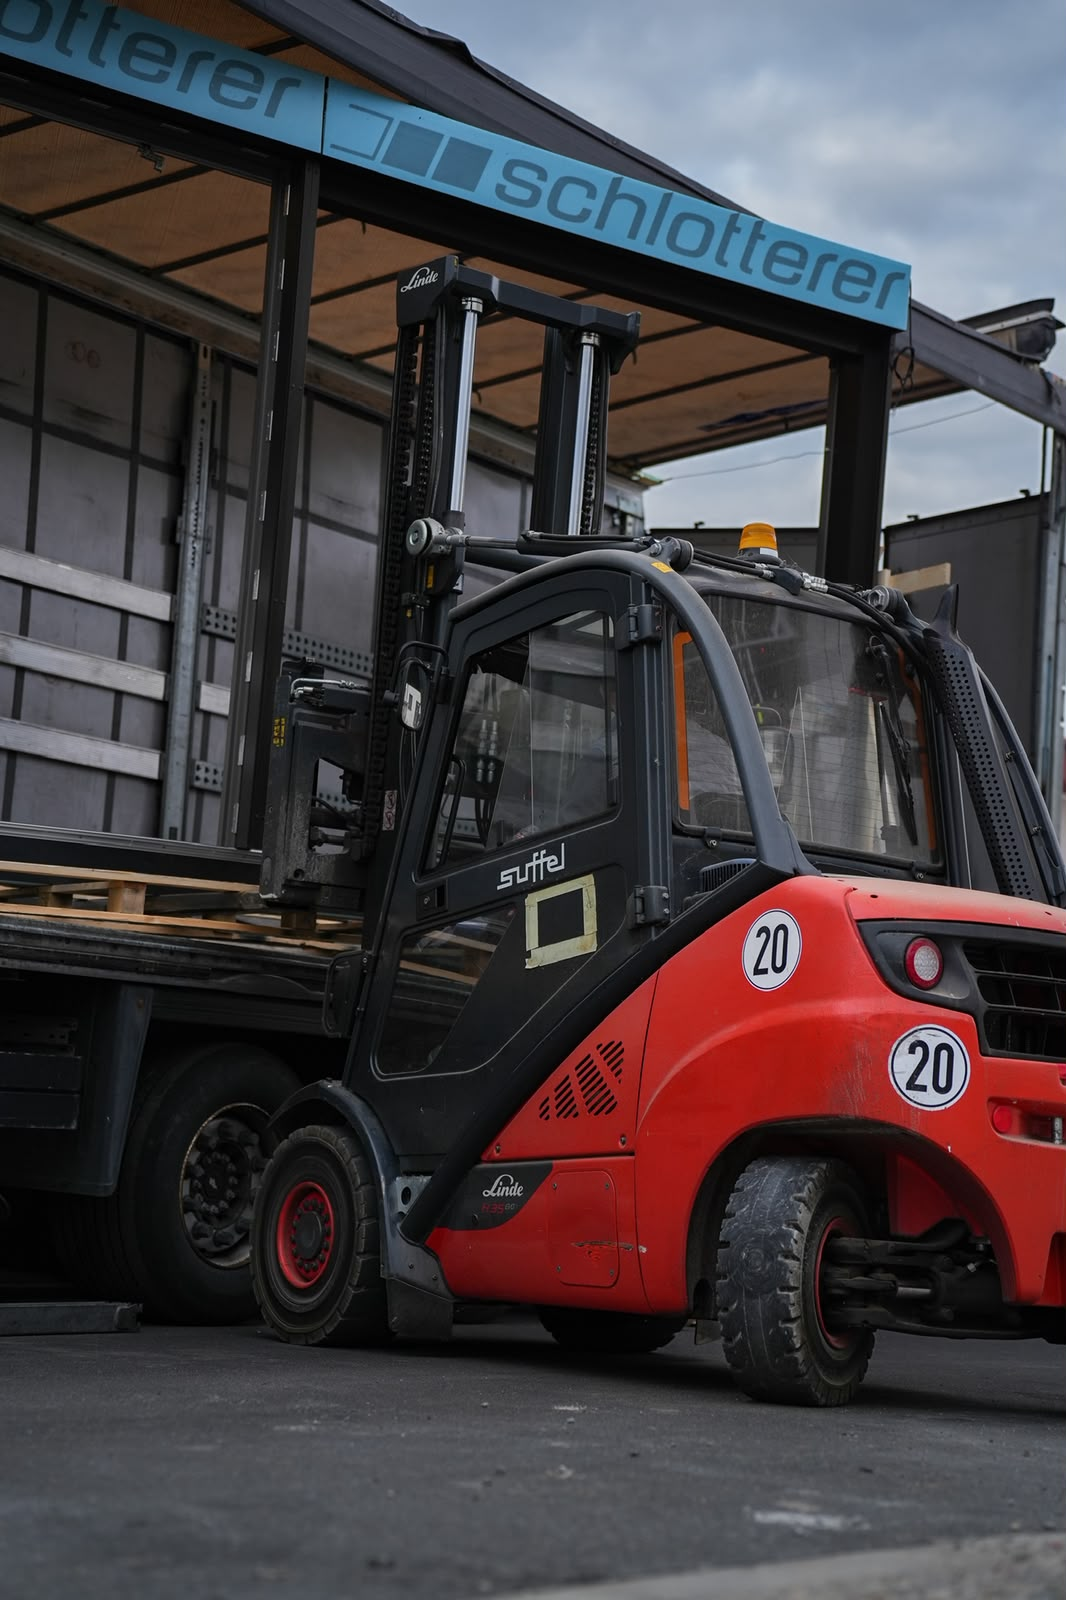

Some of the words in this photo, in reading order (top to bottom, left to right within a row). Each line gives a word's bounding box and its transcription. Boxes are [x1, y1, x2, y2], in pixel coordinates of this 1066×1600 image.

[494, 158, 906, 310] schlotterer
[400, 267, 439, 293] Linde
[496, 842, 565, 891] suffel
[753, 923, 789, 976] 20
[905, 1039, 955, 1095] 20
[482, 1173, 524, 1197] Linde
